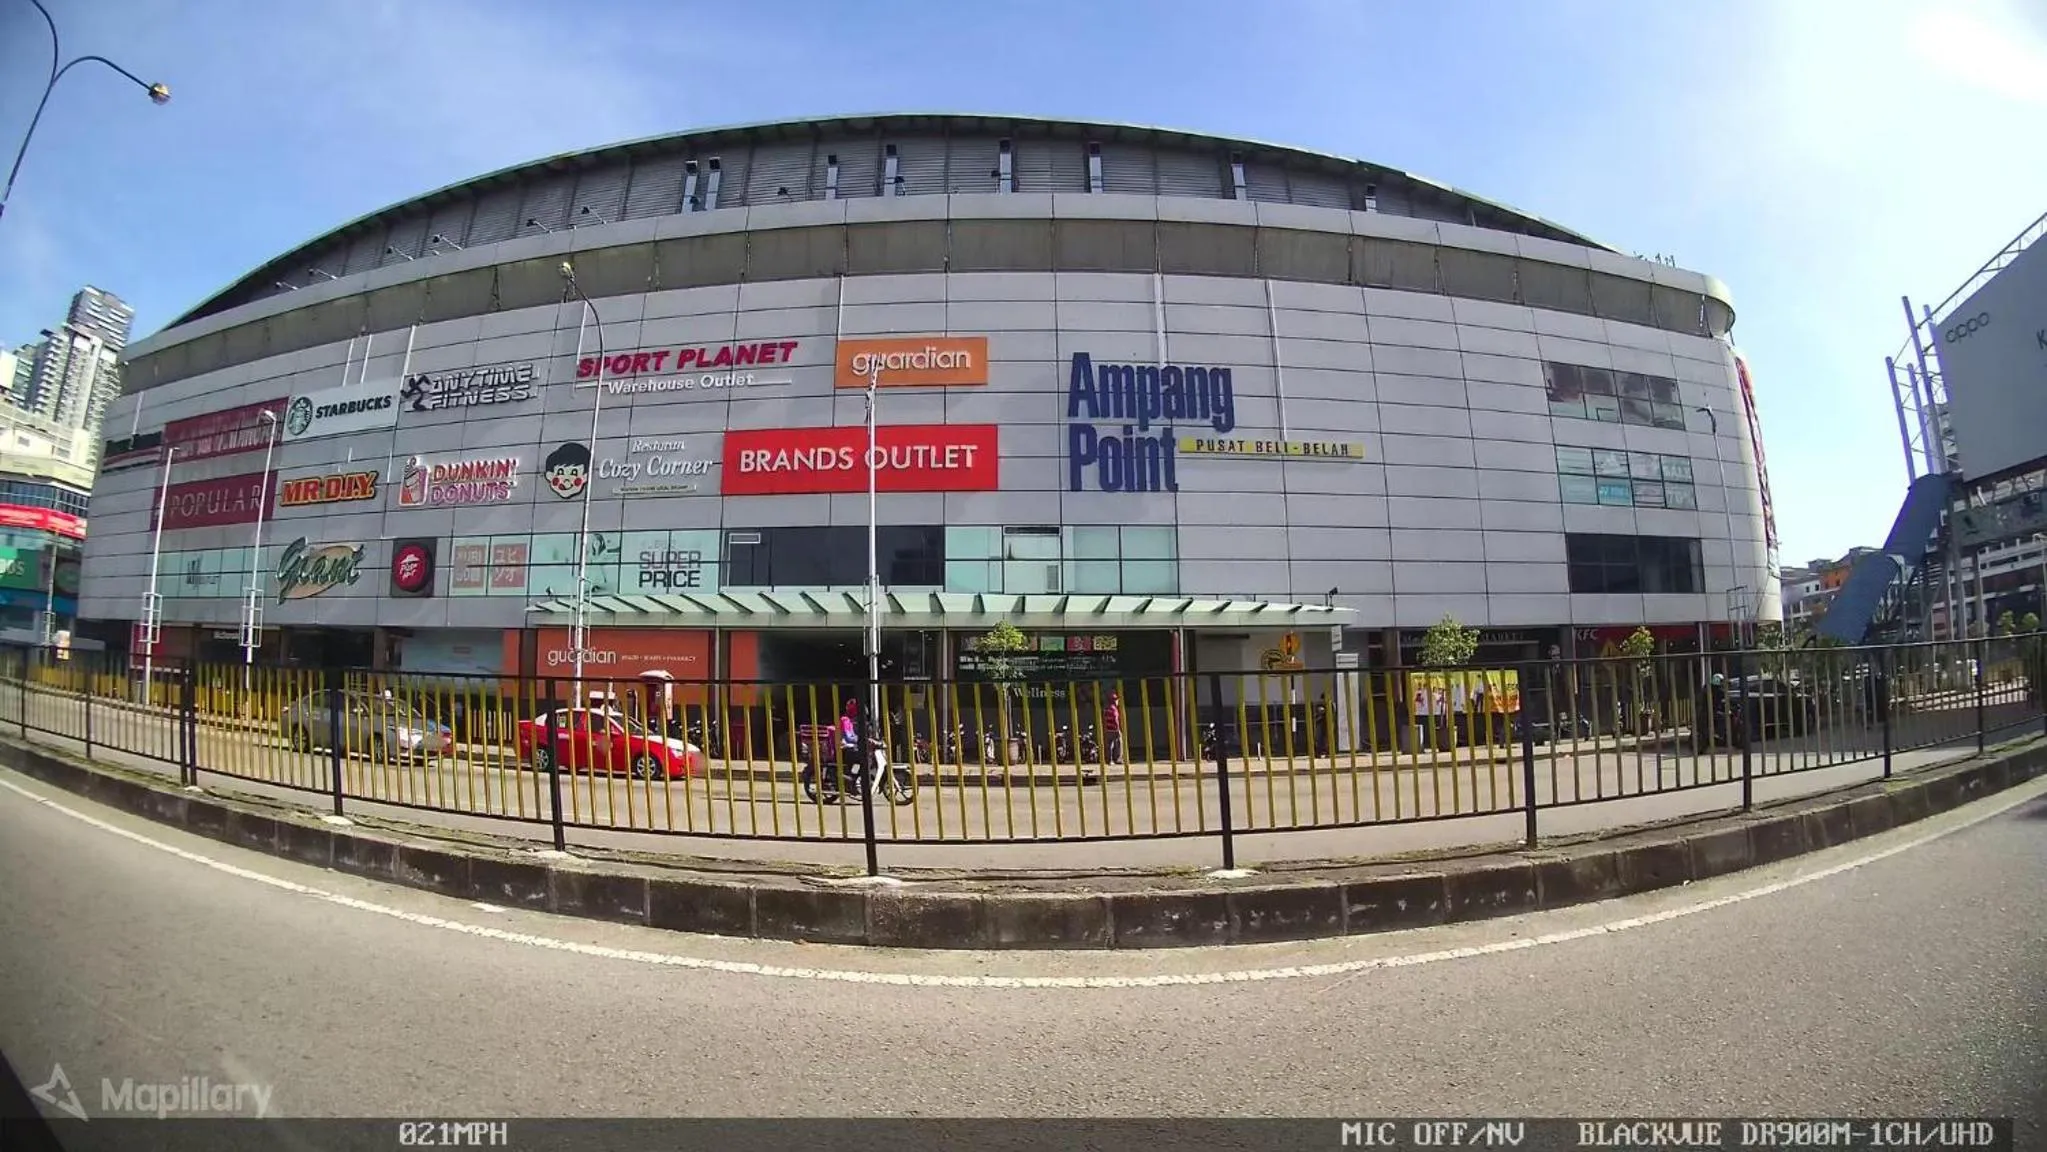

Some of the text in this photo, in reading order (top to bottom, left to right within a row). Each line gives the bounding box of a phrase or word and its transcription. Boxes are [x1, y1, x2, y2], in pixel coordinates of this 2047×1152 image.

[576, 341, 798, 378] SPORT PLANET
[852, 346, 972, 376] guardian
[431, 363, 533, 393] ANYTIME
[607, 373, 755, 395] Warehouse Outlet
[316, 395, 392, 418] STARBUCKS
[430, 384, 530, 409] FITNESS
[1068, 352, 1236, 433] Ampang
[740, 444, 979, 473] BRANDS OUTLET
[1069, 423, 1179, 493] Point
[1196, 439, 1246, 453] PUSAT
[599, 455, 713, 482] Cozy Corner
[169, 485, 262, 519] POPULAR
[639, 550, 702, 569] SUPER
[639, 570, 701, 588] PRICE
